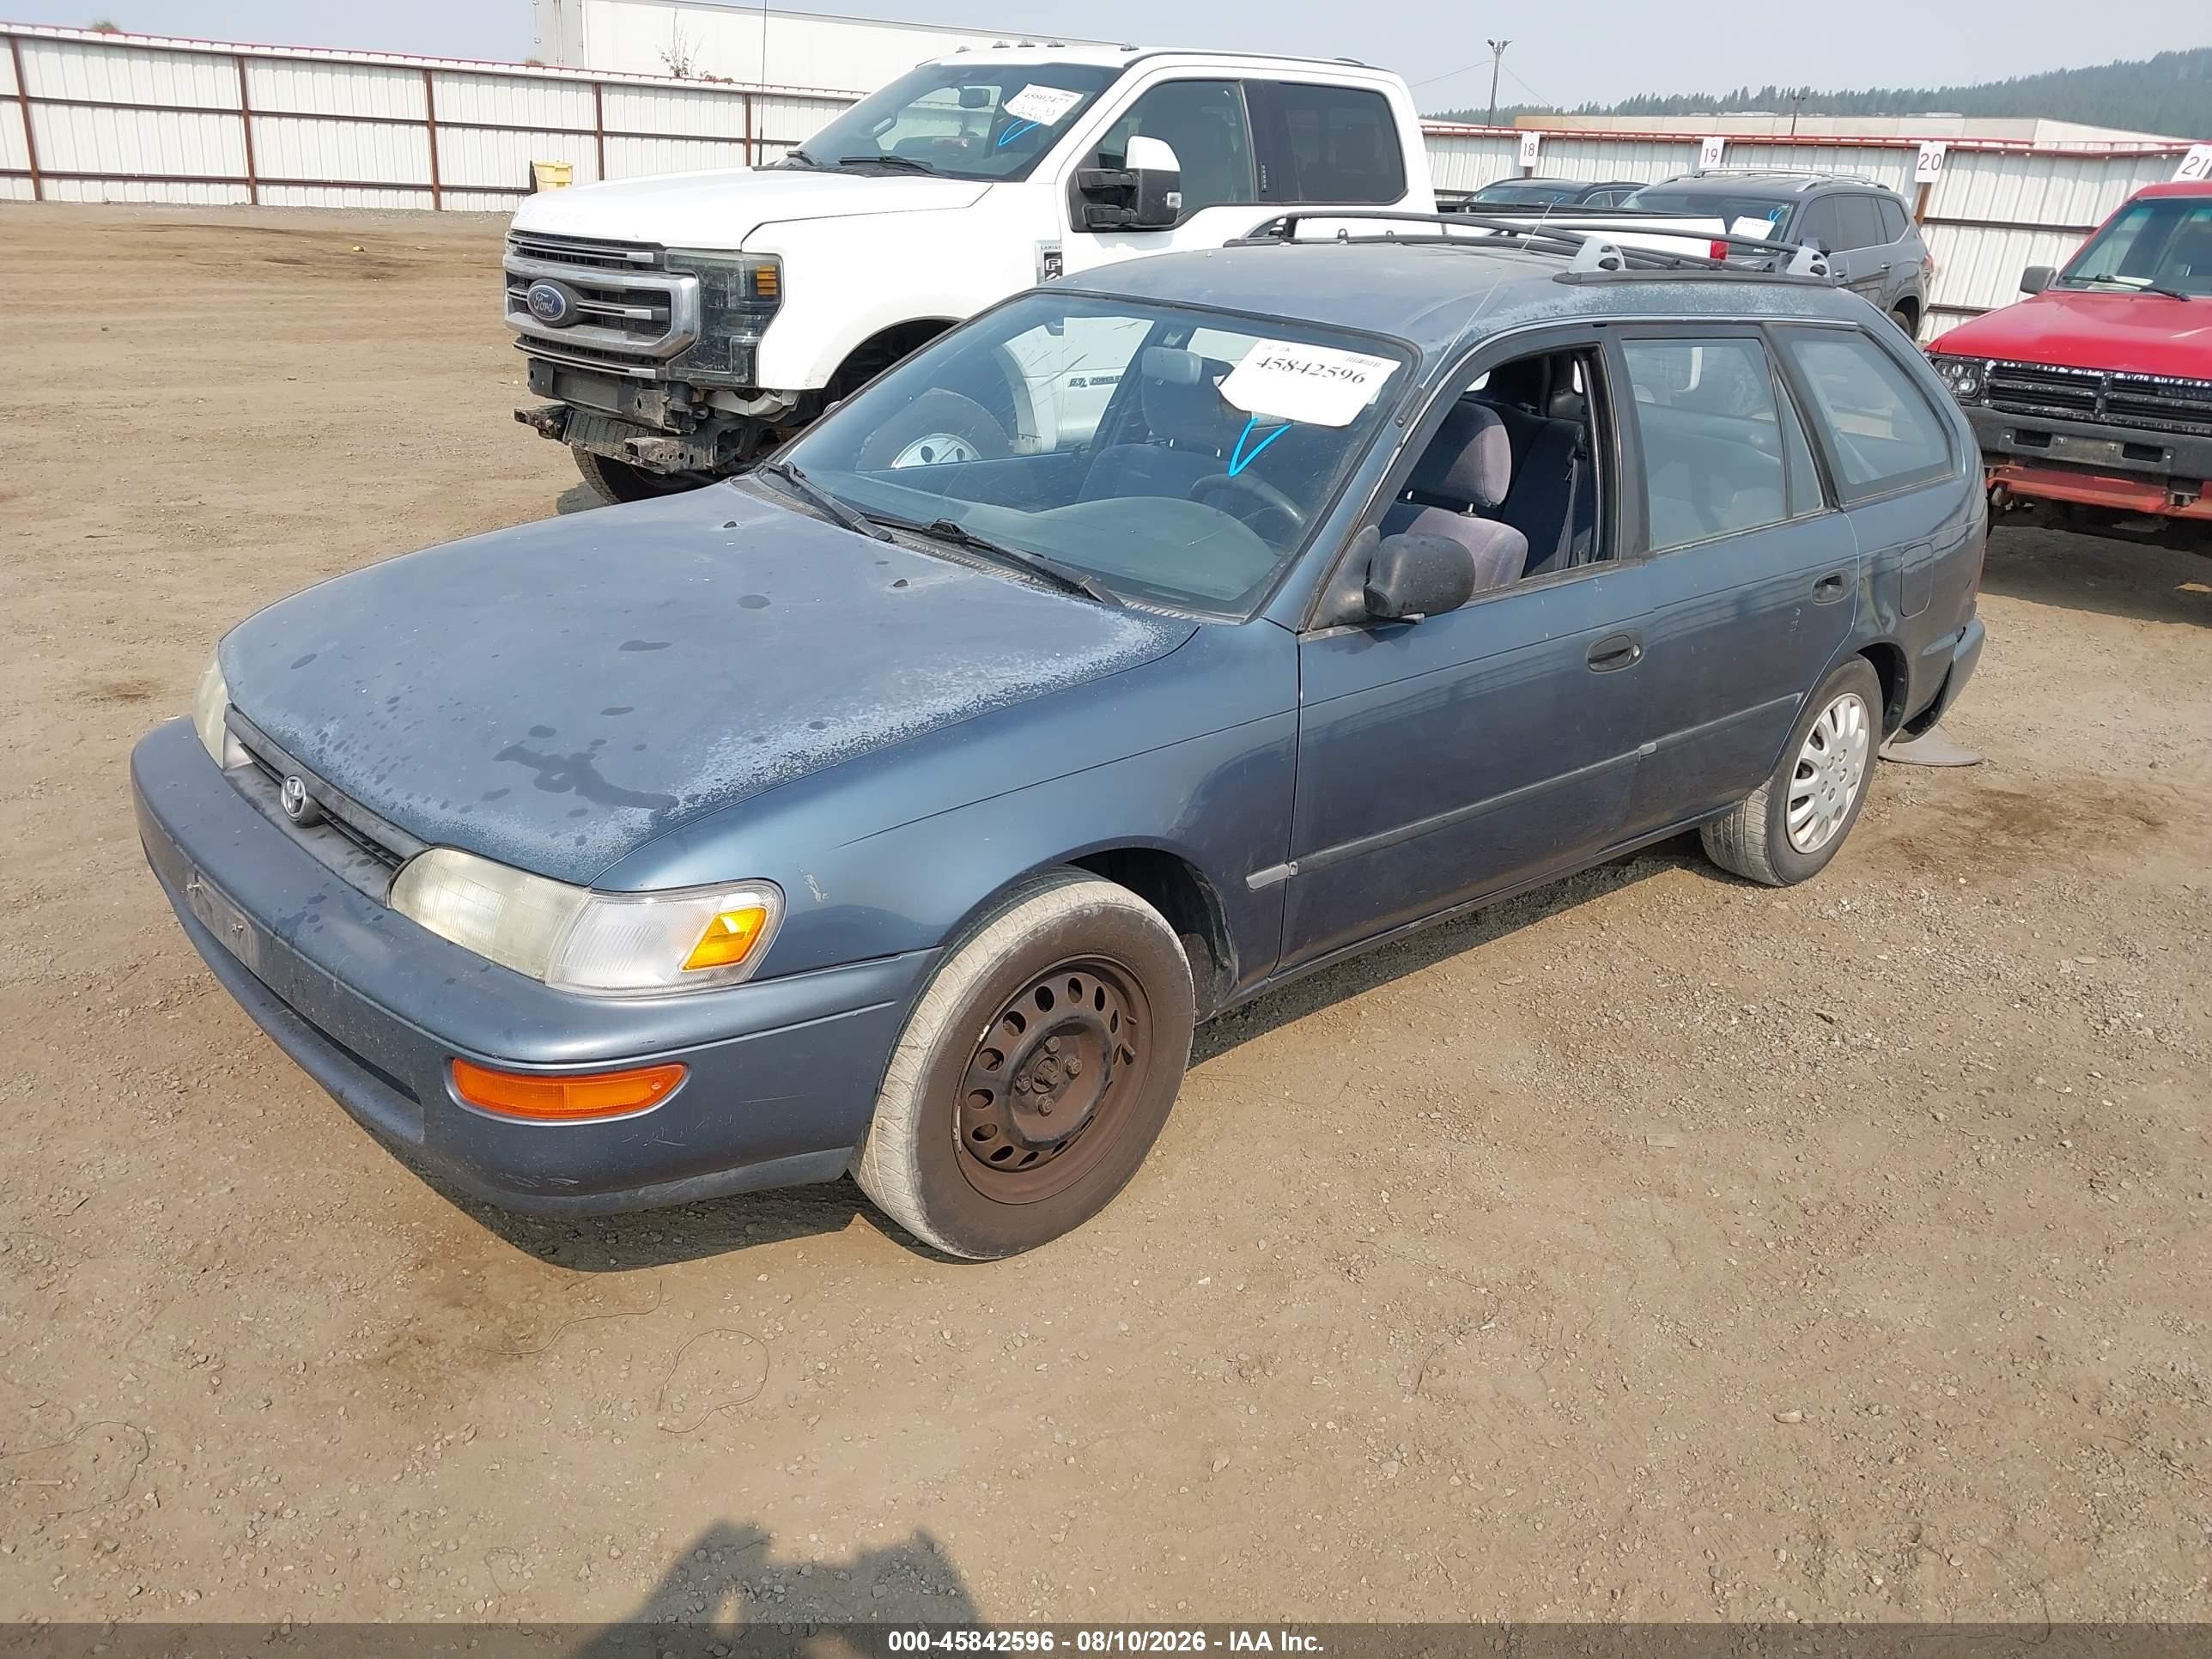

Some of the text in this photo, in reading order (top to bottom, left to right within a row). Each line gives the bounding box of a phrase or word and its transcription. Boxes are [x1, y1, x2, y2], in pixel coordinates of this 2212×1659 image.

[1523, 143, 1535, 157] 18
[1704, 148, 1718, 163] 19
[1917, 153, 1942, 171] 20
[2181, 155, 2211, 178] 21
[533, 291, 555, 313] Ford
[1255, 356, 1367, 385] 45842596
